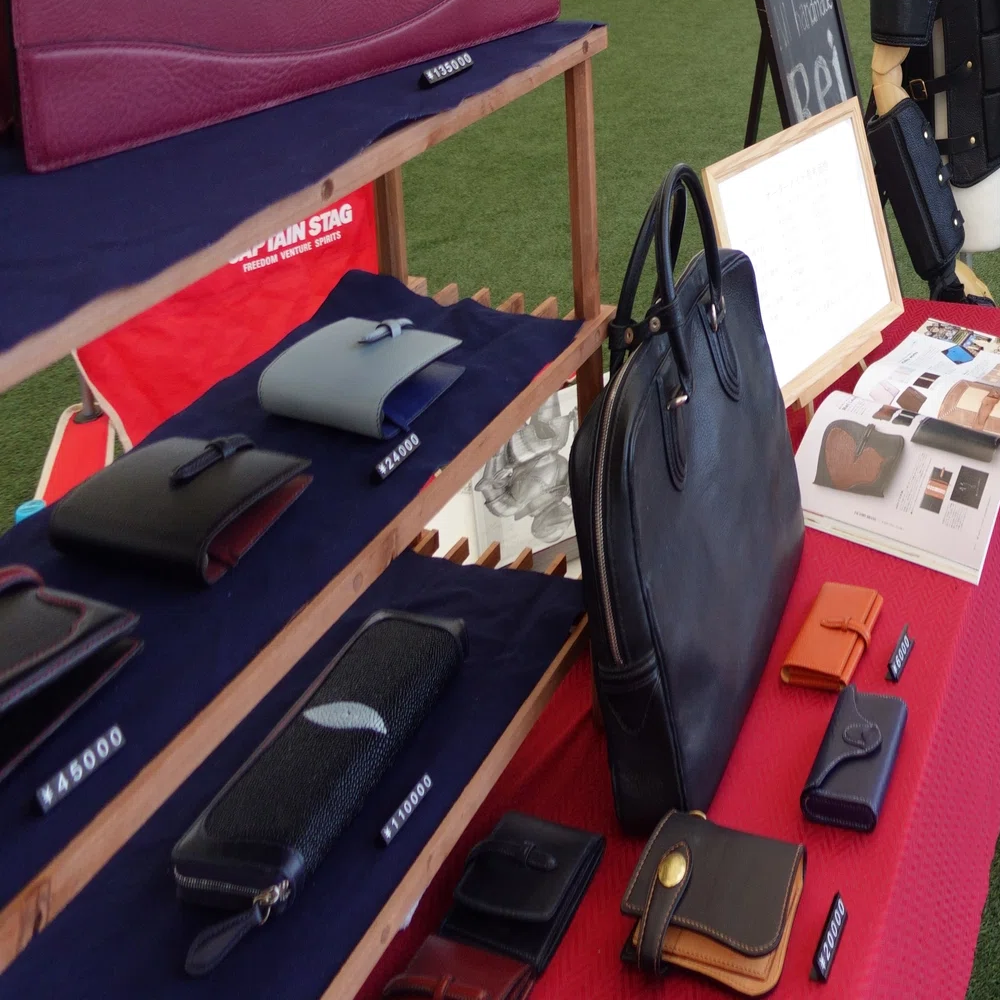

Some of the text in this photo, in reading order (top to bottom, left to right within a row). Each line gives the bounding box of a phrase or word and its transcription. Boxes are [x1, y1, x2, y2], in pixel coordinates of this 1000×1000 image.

[426, 52, 472, 80] ¥135000
[229, 203, 352, 265] PTAIN STAG
[243, 231, 342, 273] FREEDOM VENTURE SPIRITS
[379, 433, 419, 475] ¥24000
[41, 725, 122, 805] ¥45000
[384, 774, 432, 839] ¥110000
[819, 898, 845, 970] ¥20000
